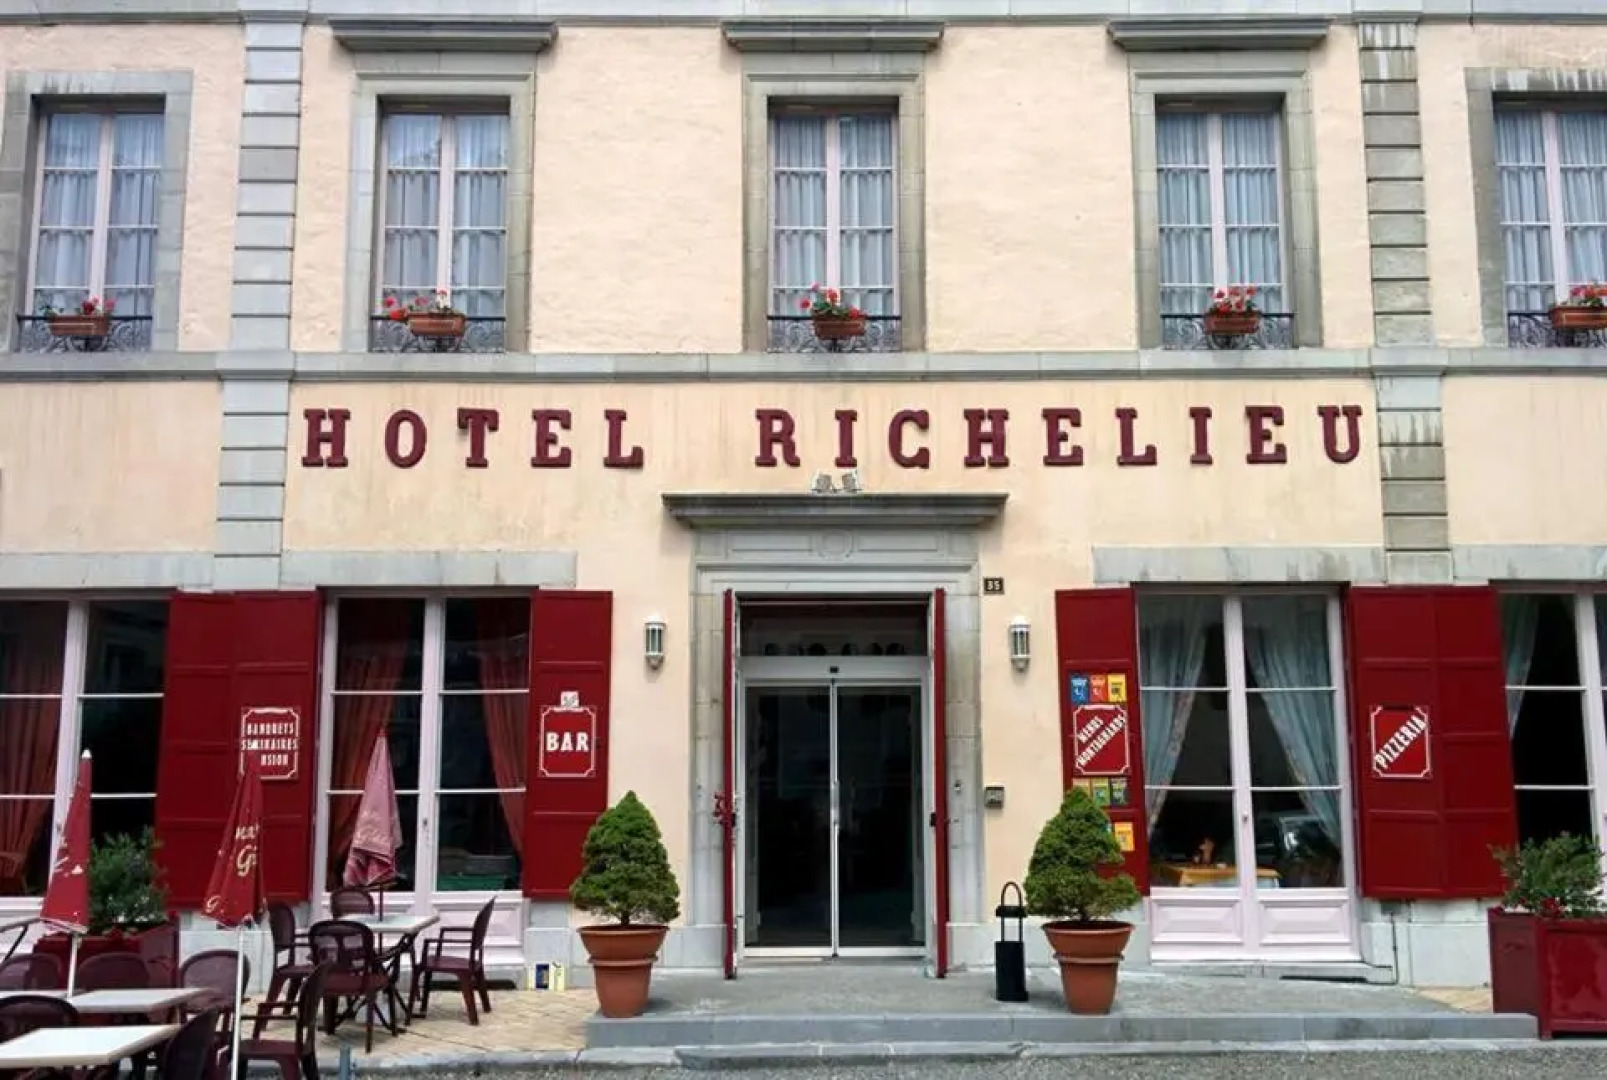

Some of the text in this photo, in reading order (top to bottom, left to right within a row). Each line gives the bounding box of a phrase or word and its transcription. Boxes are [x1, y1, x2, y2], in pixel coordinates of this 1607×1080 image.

[301, 405, 1363, 469] HOTEL RICHELIEU
[260, 754, 289, 766] NSION
[546, 731, 590, 752] BAR
[1373, 714, 1427, 769] PIZZERIA
